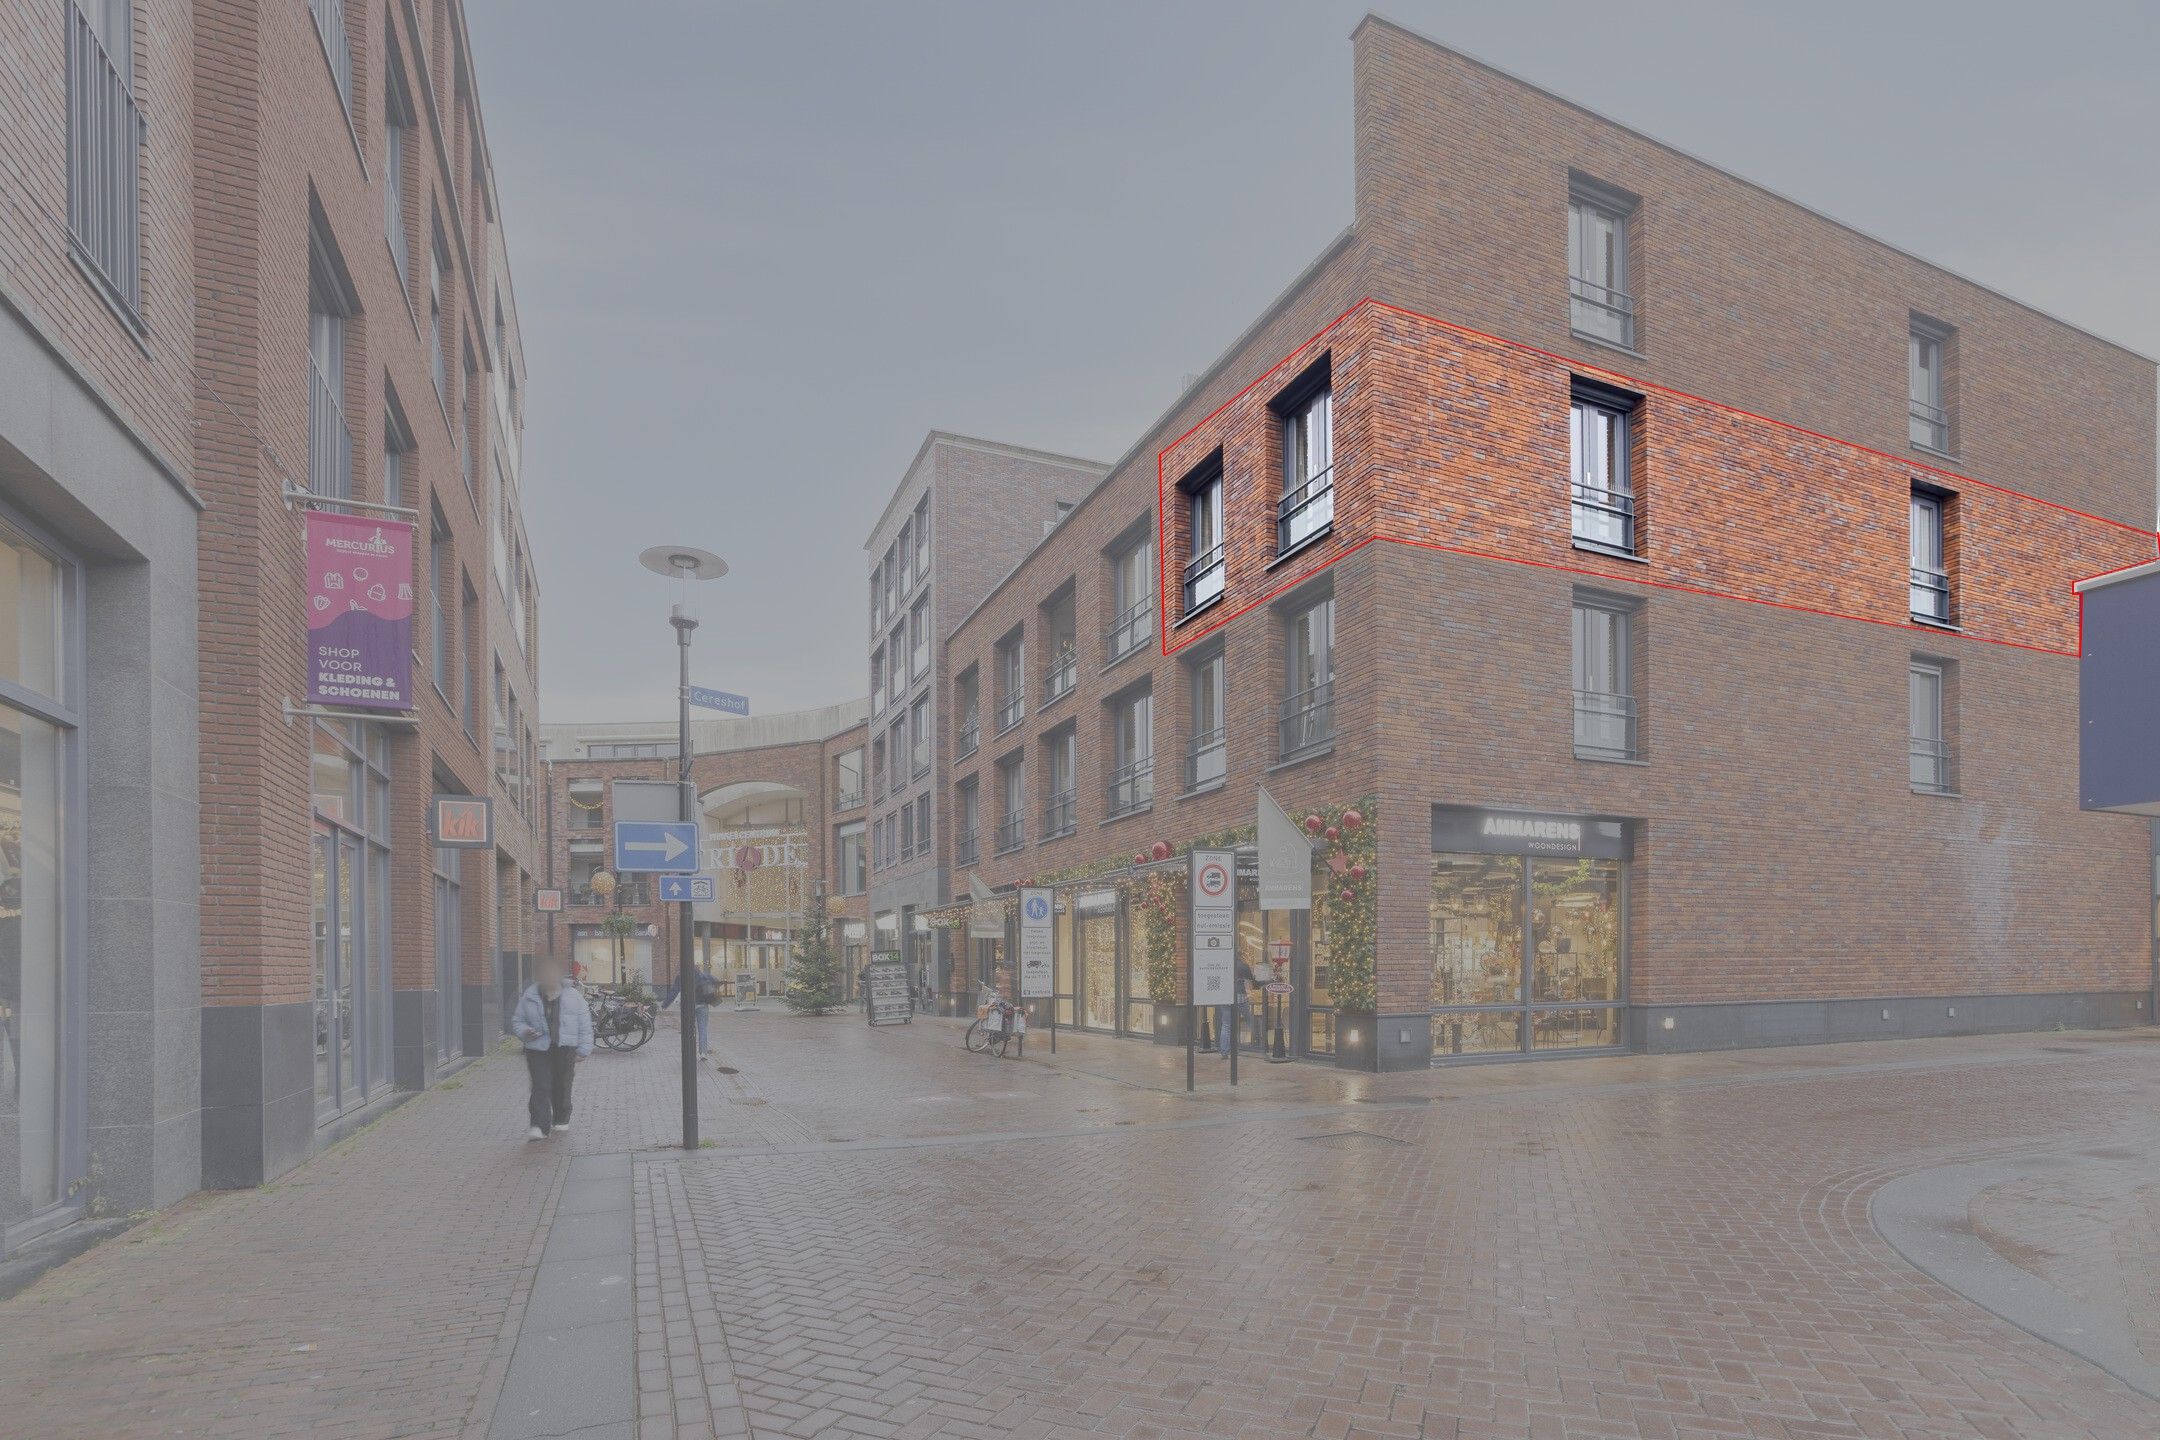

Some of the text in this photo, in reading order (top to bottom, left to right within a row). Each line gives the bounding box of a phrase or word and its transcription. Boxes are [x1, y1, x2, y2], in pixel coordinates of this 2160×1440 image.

[325, 538, 395, 554] MERCURIUS
[319, 646, 360, 659] SHOP
[319, 659, 362, 672] VOOR
[318, 672, 396, 688] KLEDING &
[318, 685, 400, 701] SCHOENEN
[694, 690, 747, 711] Cereshof
[1482, 817, 1579, 839] AMMARENS
[1528, 841, 1577, 851] WOONDESIGN
